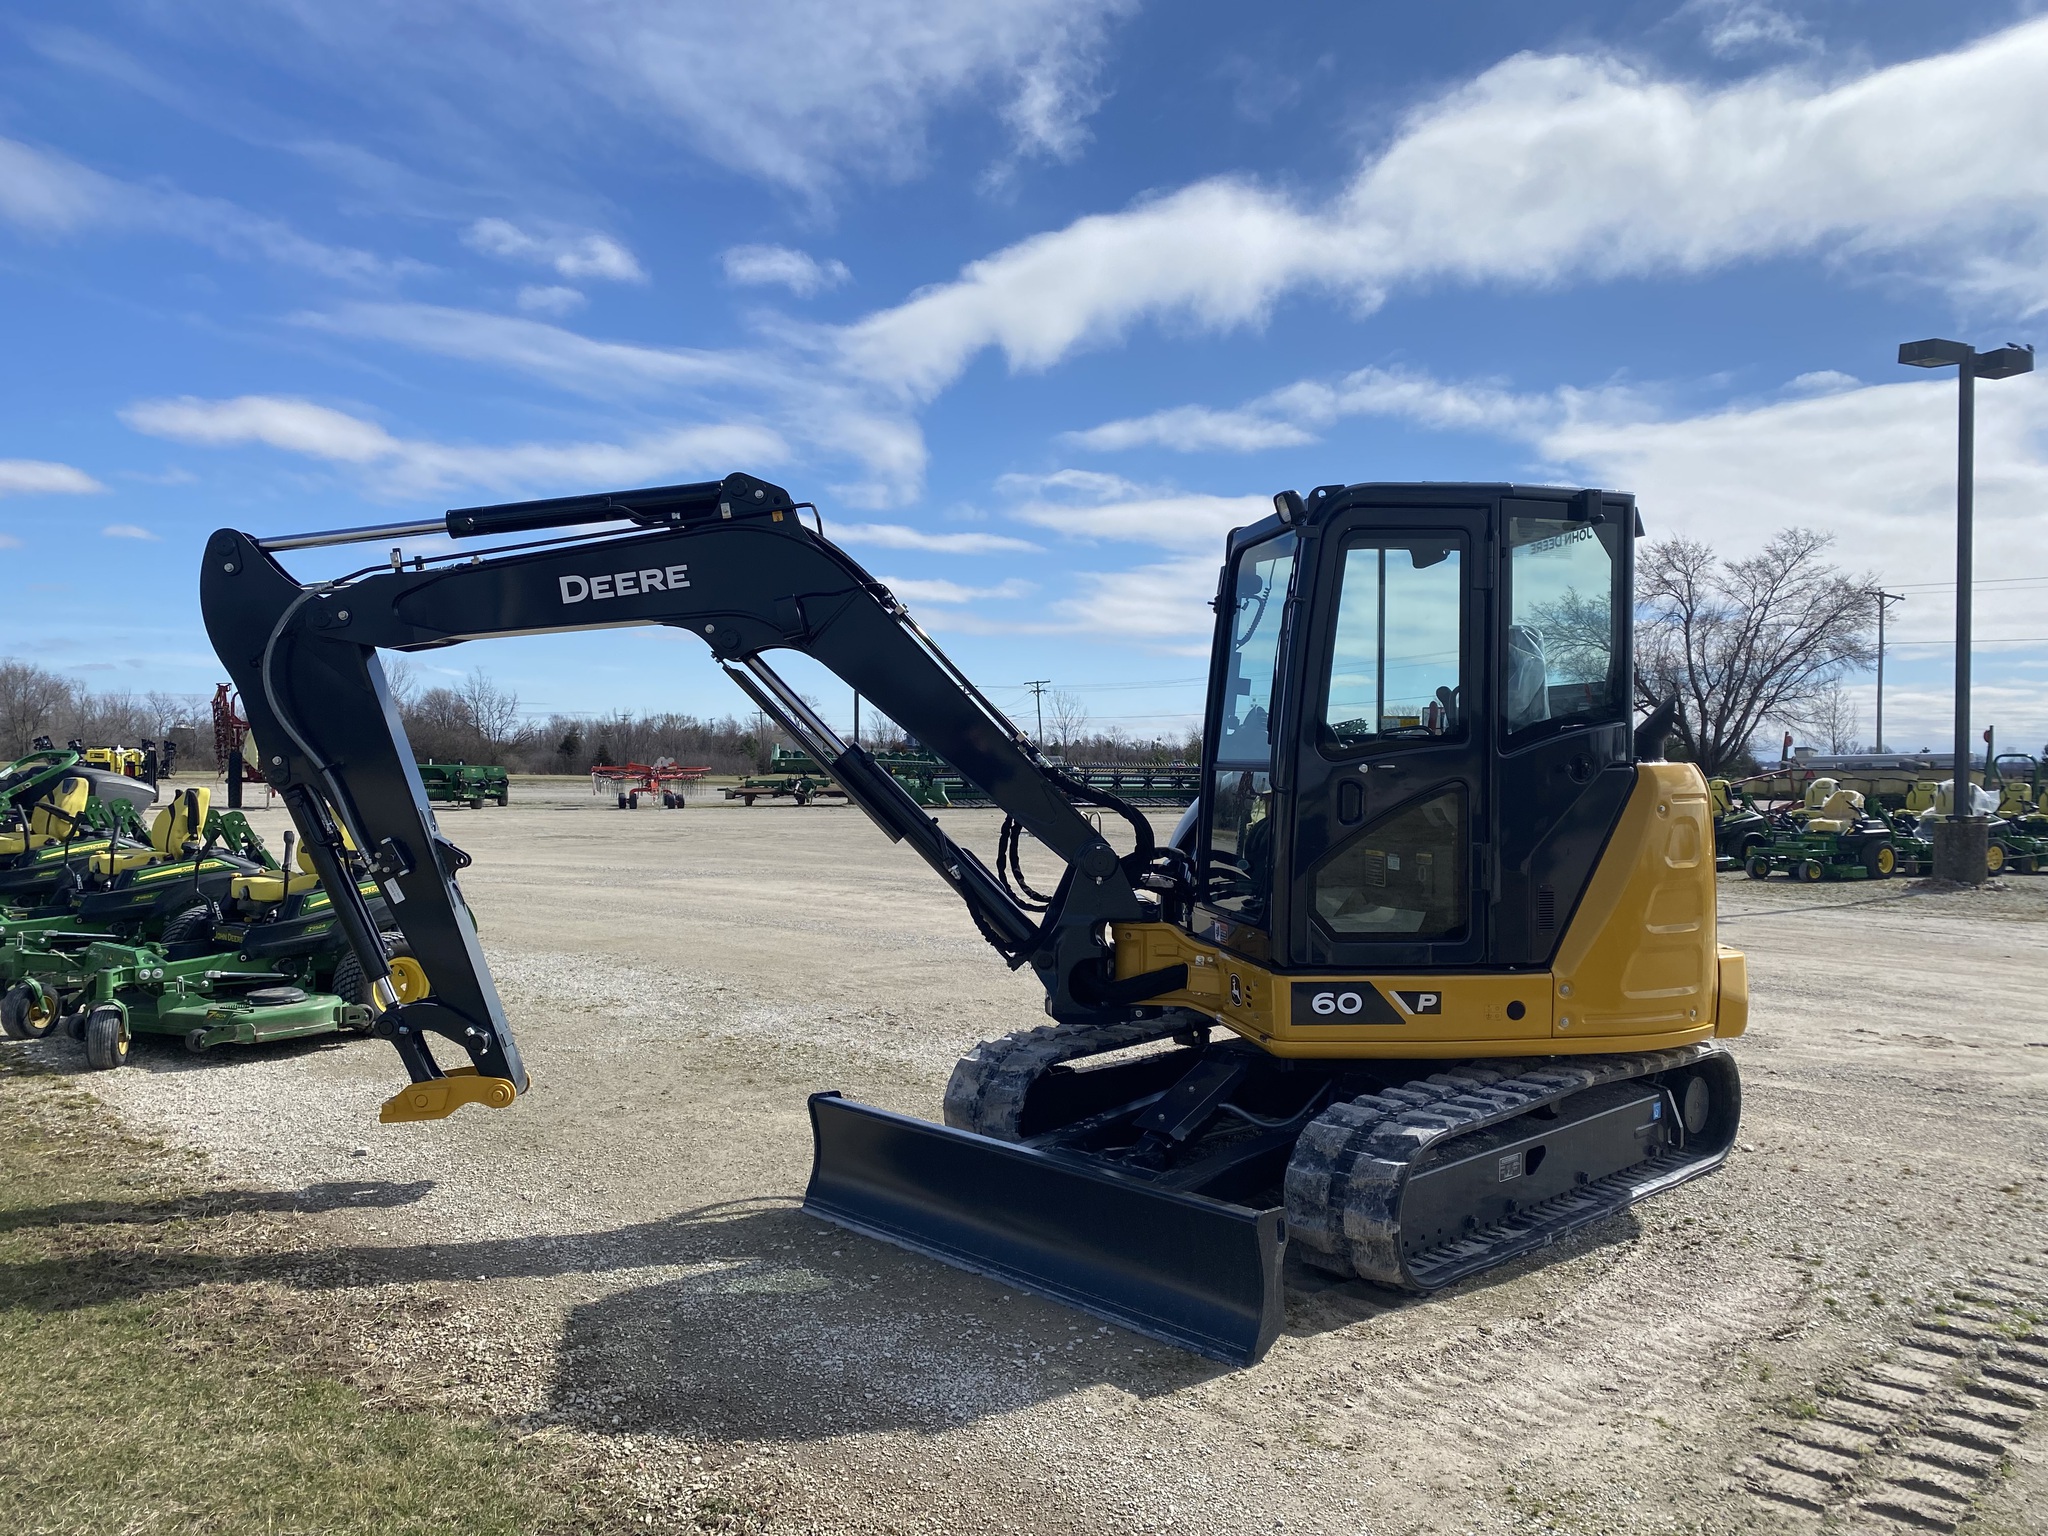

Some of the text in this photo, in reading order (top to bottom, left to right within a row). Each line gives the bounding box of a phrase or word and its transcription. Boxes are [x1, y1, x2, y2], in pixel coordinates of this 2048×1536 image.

[559, 564, 690, 604] DEERE
[214, 931, 228, 941] JOHN
[1311, 992, 1437, 1015] 60 P
